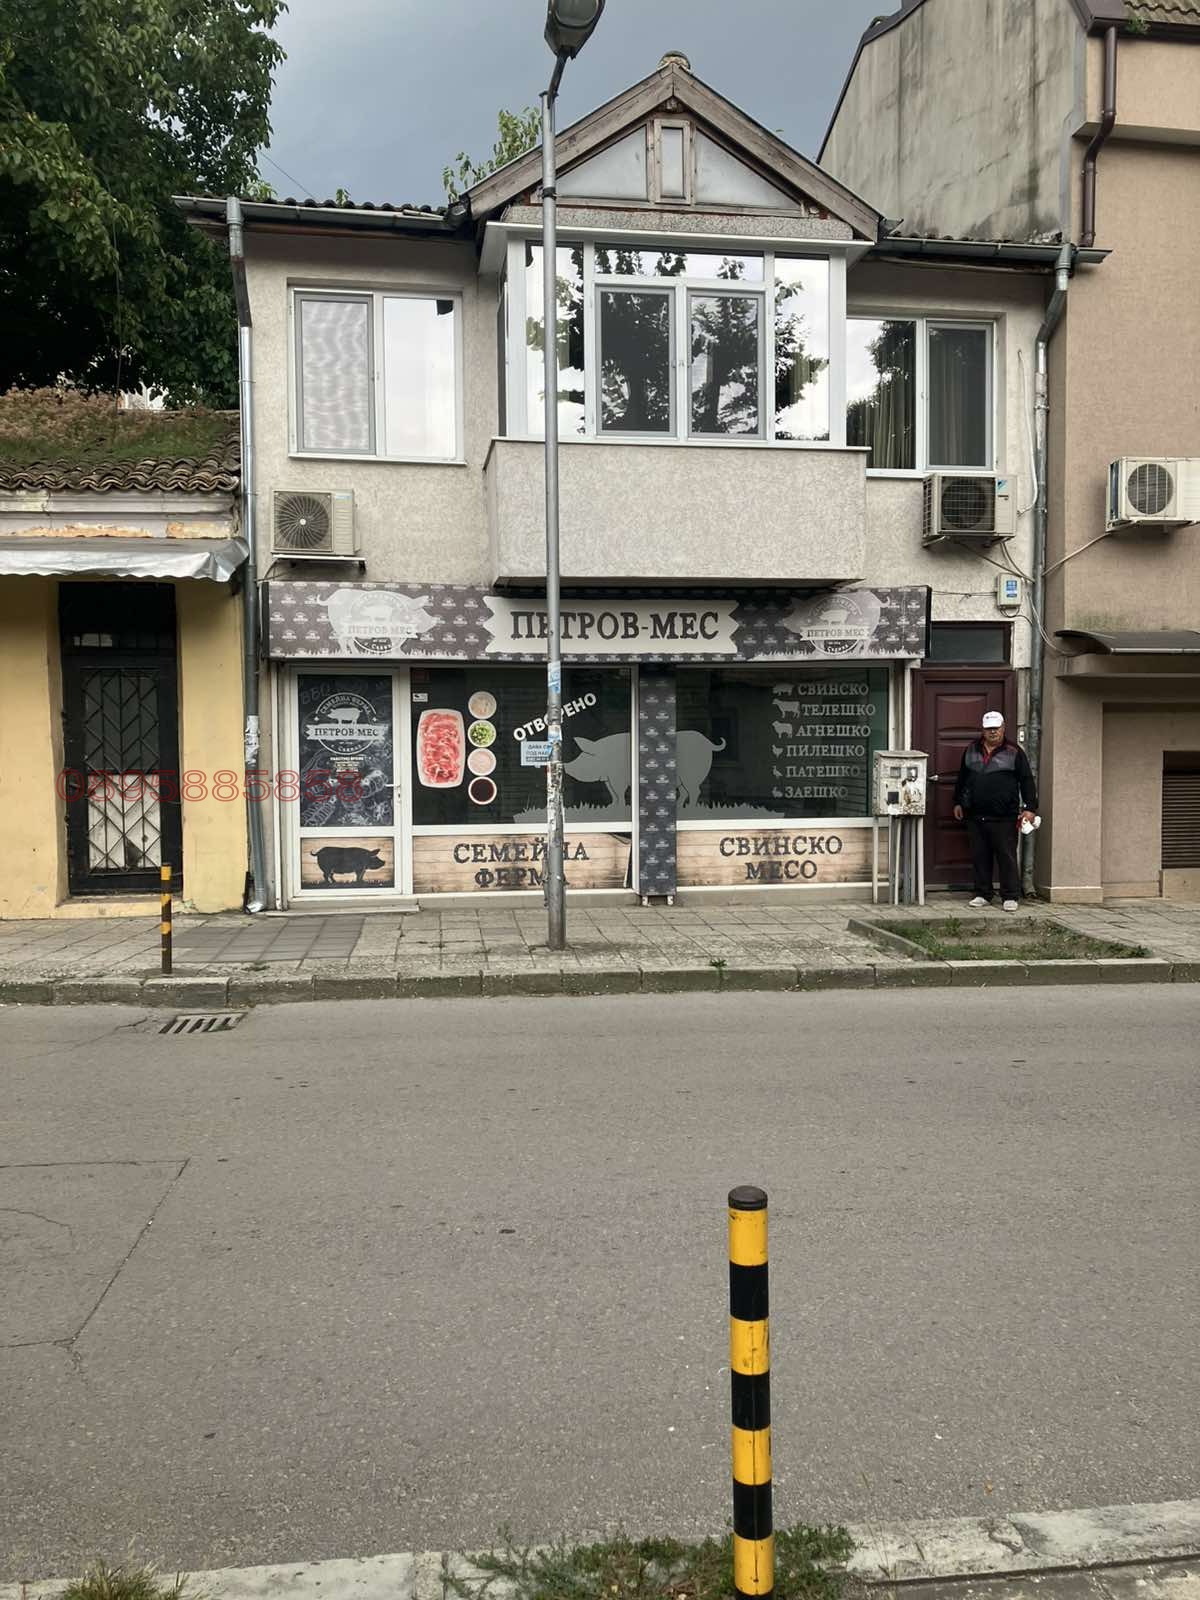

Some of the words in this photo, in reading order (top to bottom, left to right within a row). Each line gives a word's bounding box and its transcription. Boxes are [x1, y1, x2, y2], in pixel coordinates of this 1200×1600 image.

[798, 683, 869, 696] СВИНСКО
[801, 704, 876, 716] ТЕЛЕШКО
[513, 693, 597, 741] ОТВЕНО
[795, 725, 871, 737] АГНЕШКО
[786, 745, 865, 757] ПИЛЕШКО
[786, 766, 860, 778] ПАТЕШКО
[784, 786, 848, 799] ЗАЕШКО
[719, 835, 843, 857] СВИНСКО
[745, 860, 818, 880] МЕСО
[474, 868, 570, 888] ФЕРМ
